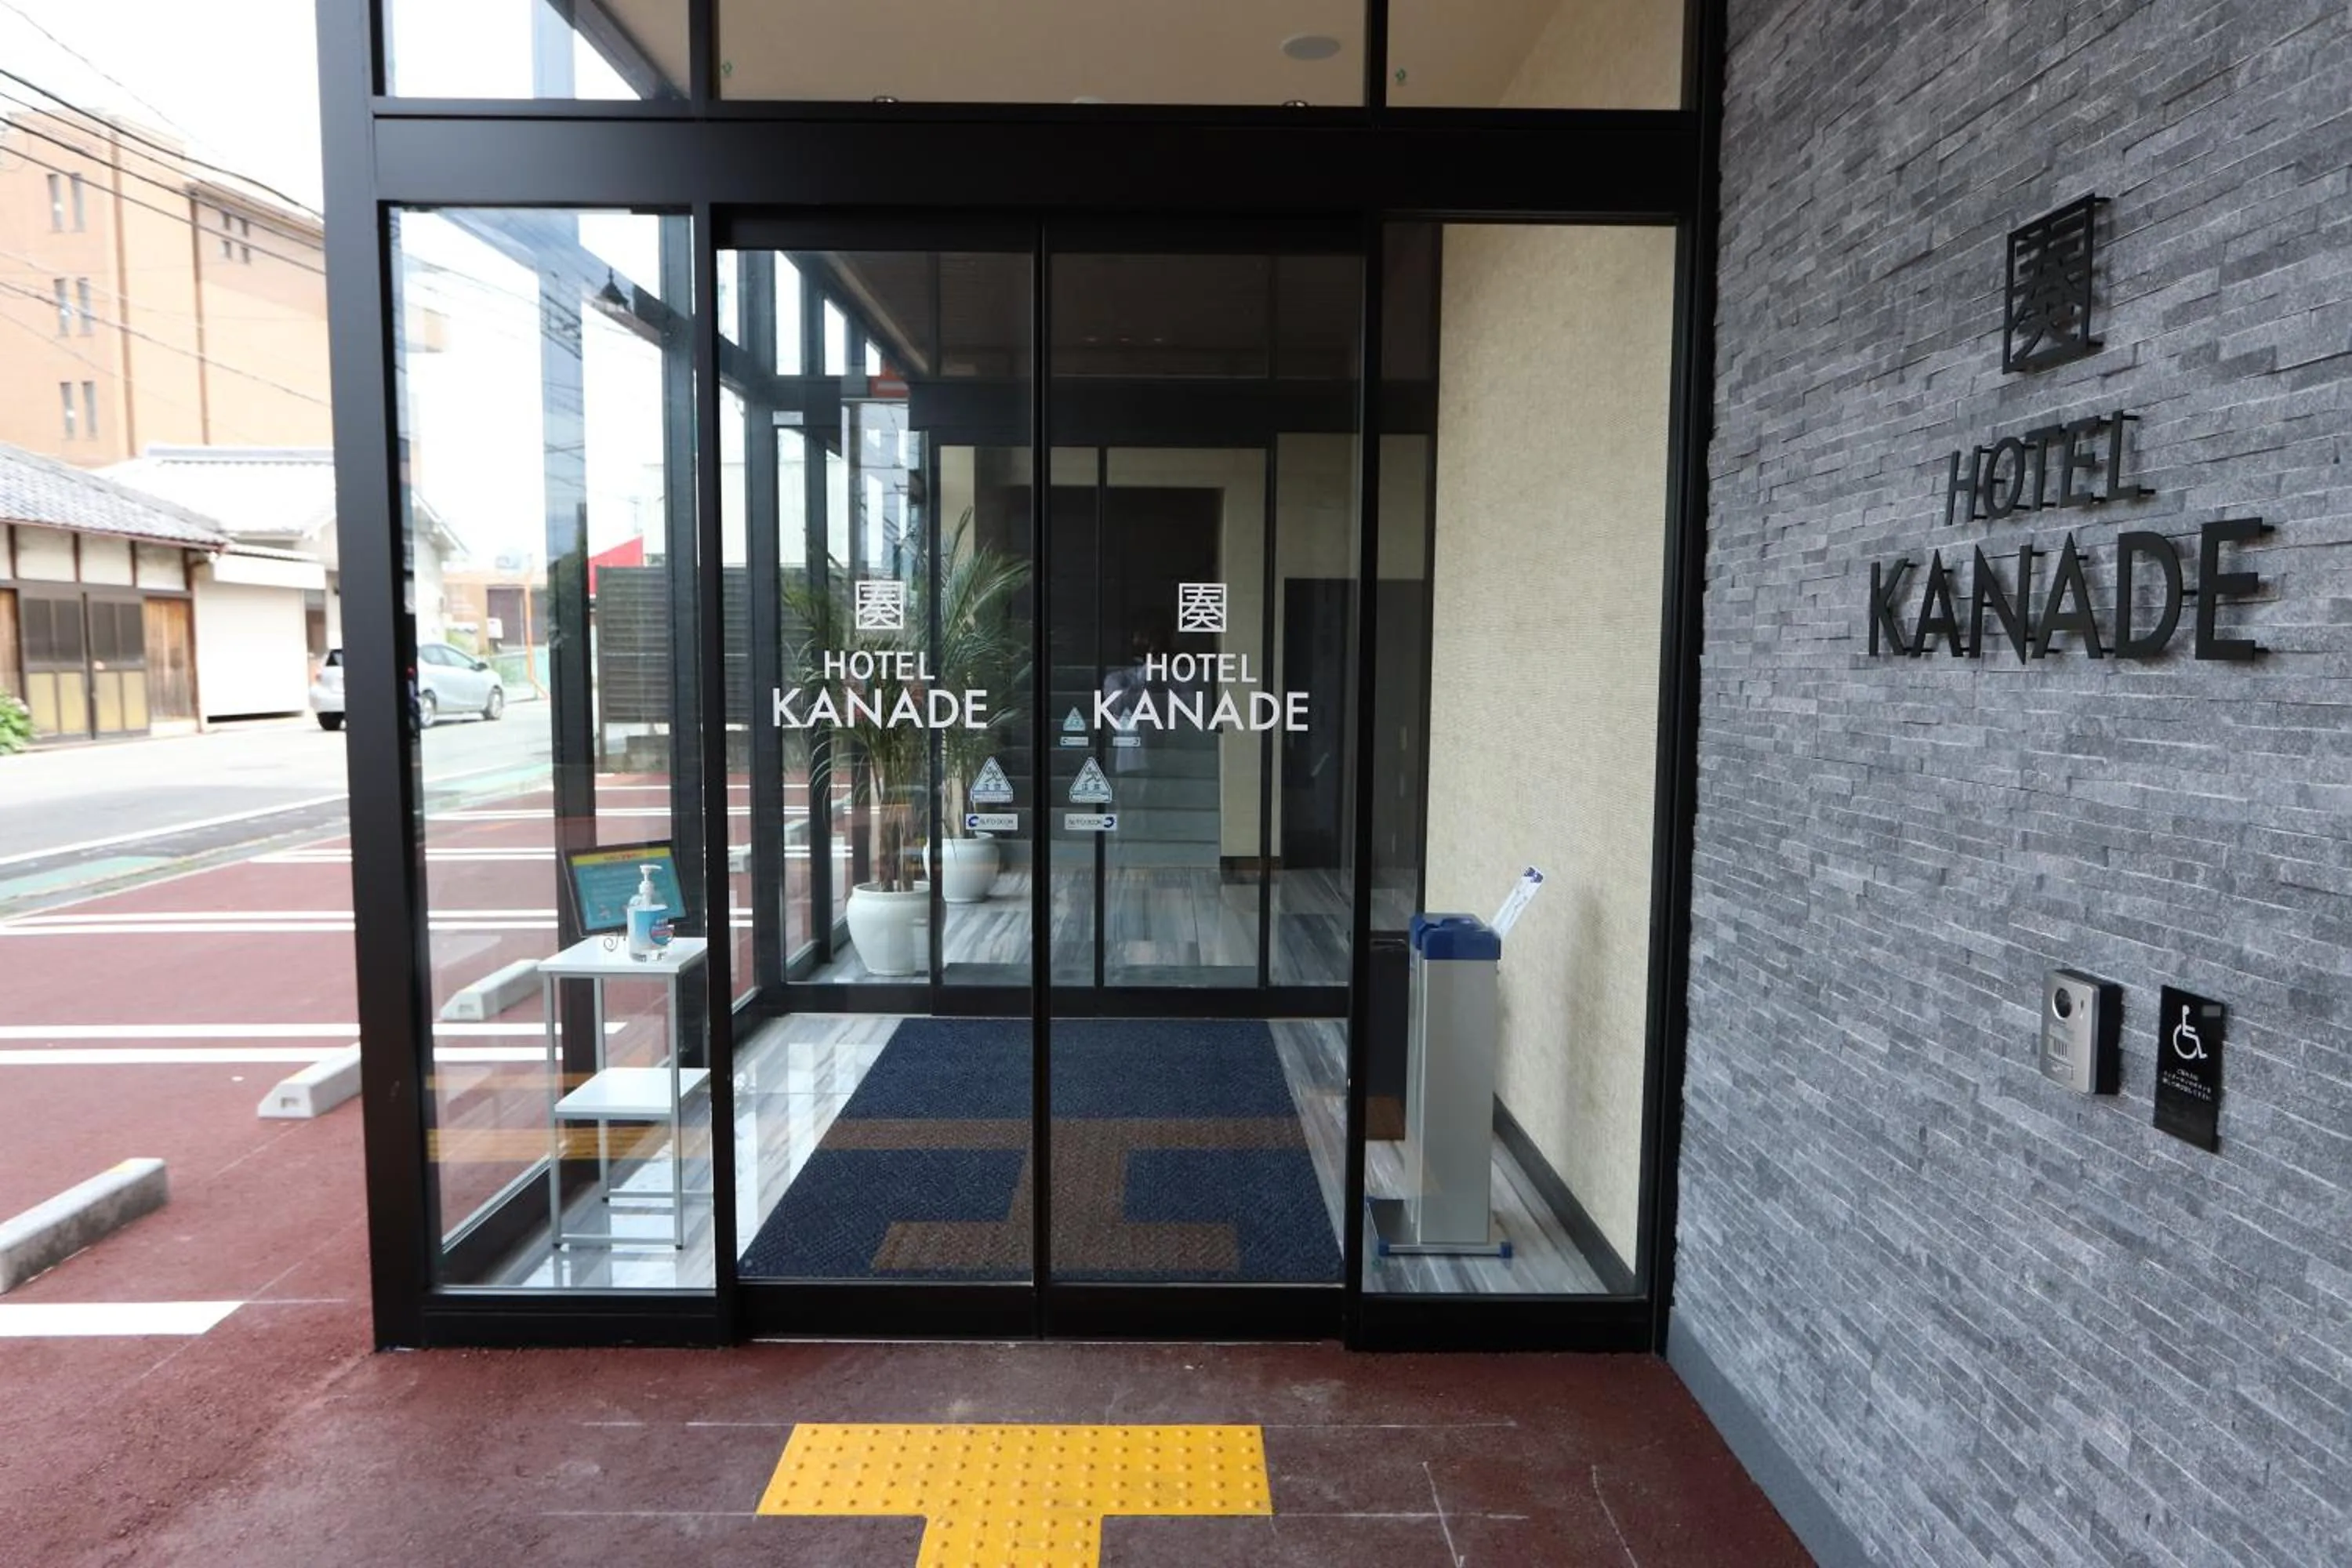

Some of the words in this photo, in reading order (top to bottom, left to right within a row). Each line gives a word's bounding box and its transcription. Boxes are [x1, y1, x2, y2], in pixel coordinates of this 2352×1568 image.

[1944, 409, 2141, 526] HOTEL
[1868, 517, 2264, 665] KANADE
[824, 650, 935, 681] HOTEL
[1146, 652, 1258, 683] HOTEL
[772, 688, 988, 729] KANADE
[1094, 690, 1309, 731] KANADE
